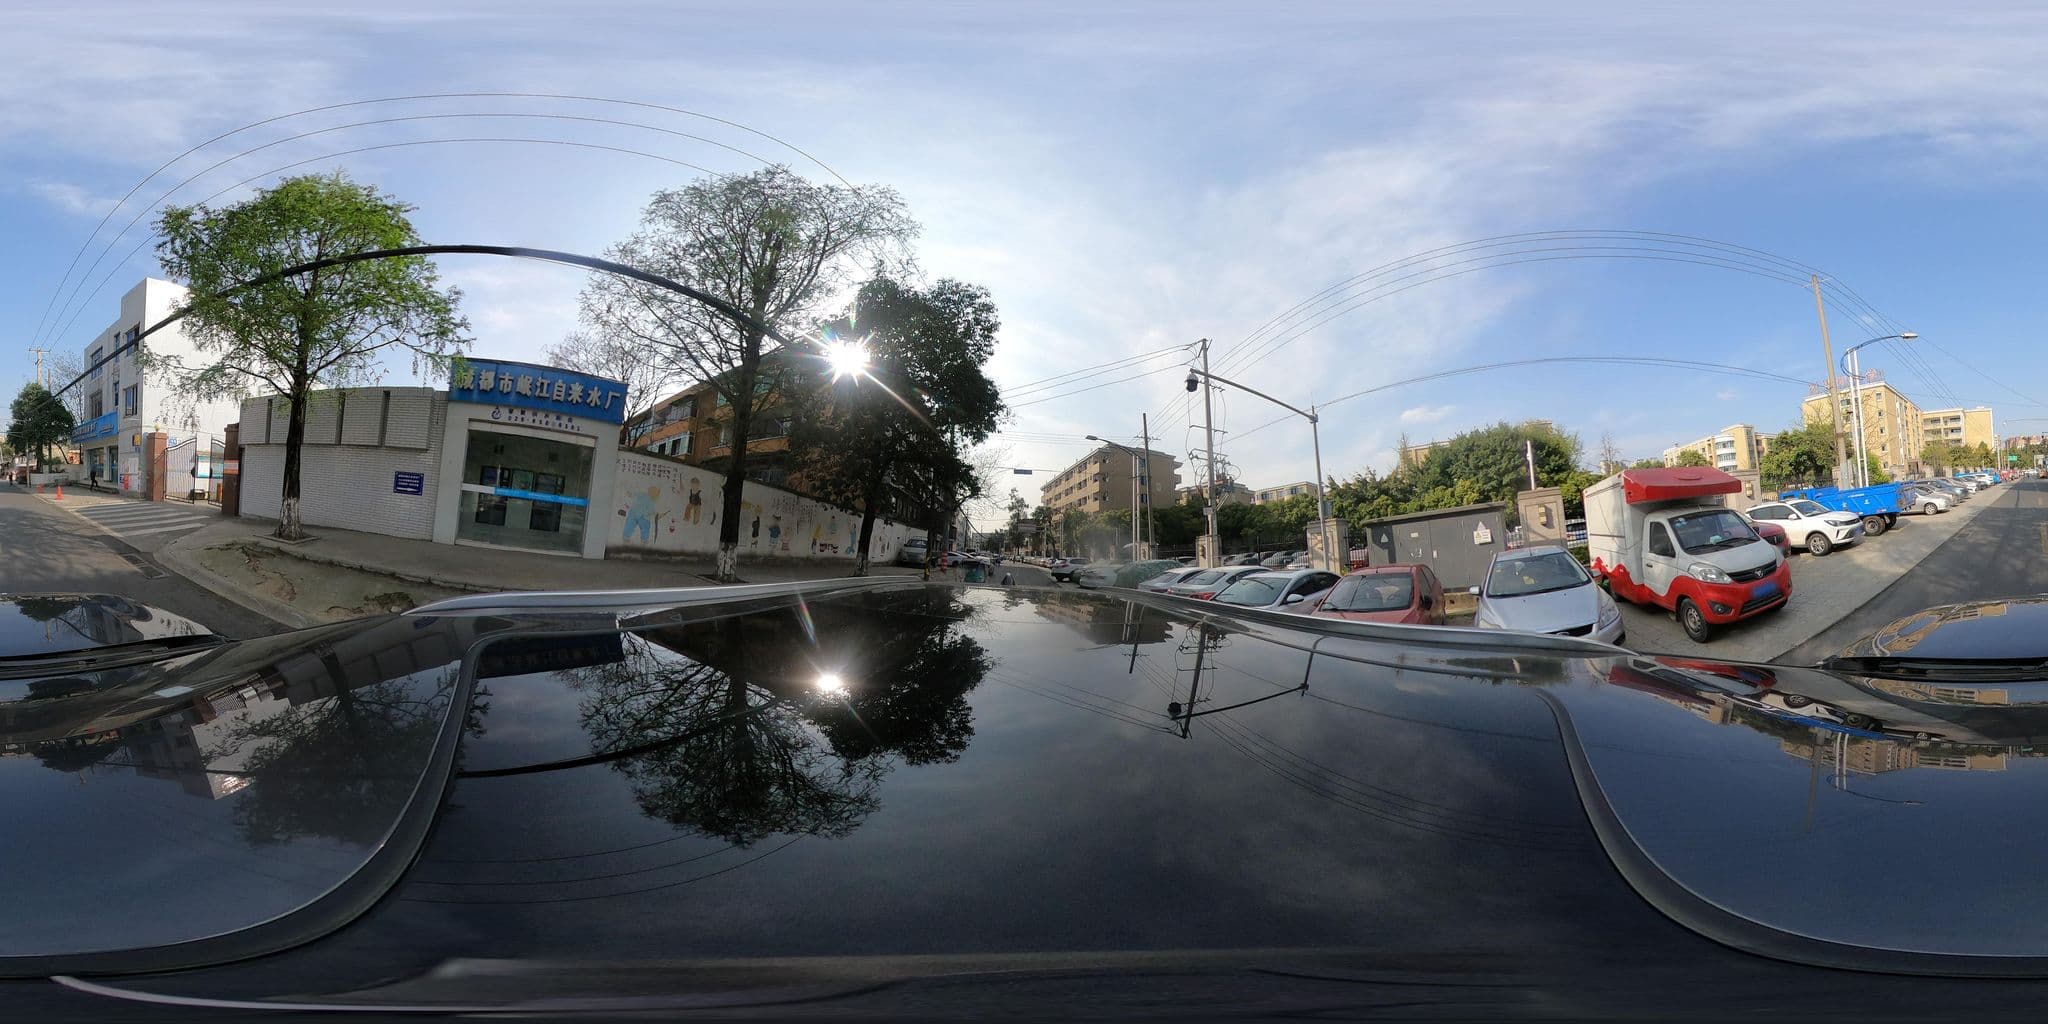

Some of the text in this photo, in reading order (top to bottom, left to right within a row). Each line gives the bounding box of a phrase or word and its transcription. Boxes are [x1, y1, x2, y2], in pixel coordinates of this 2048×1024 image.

[459, 368, 621, 410] 成都市岷江自来水厂
